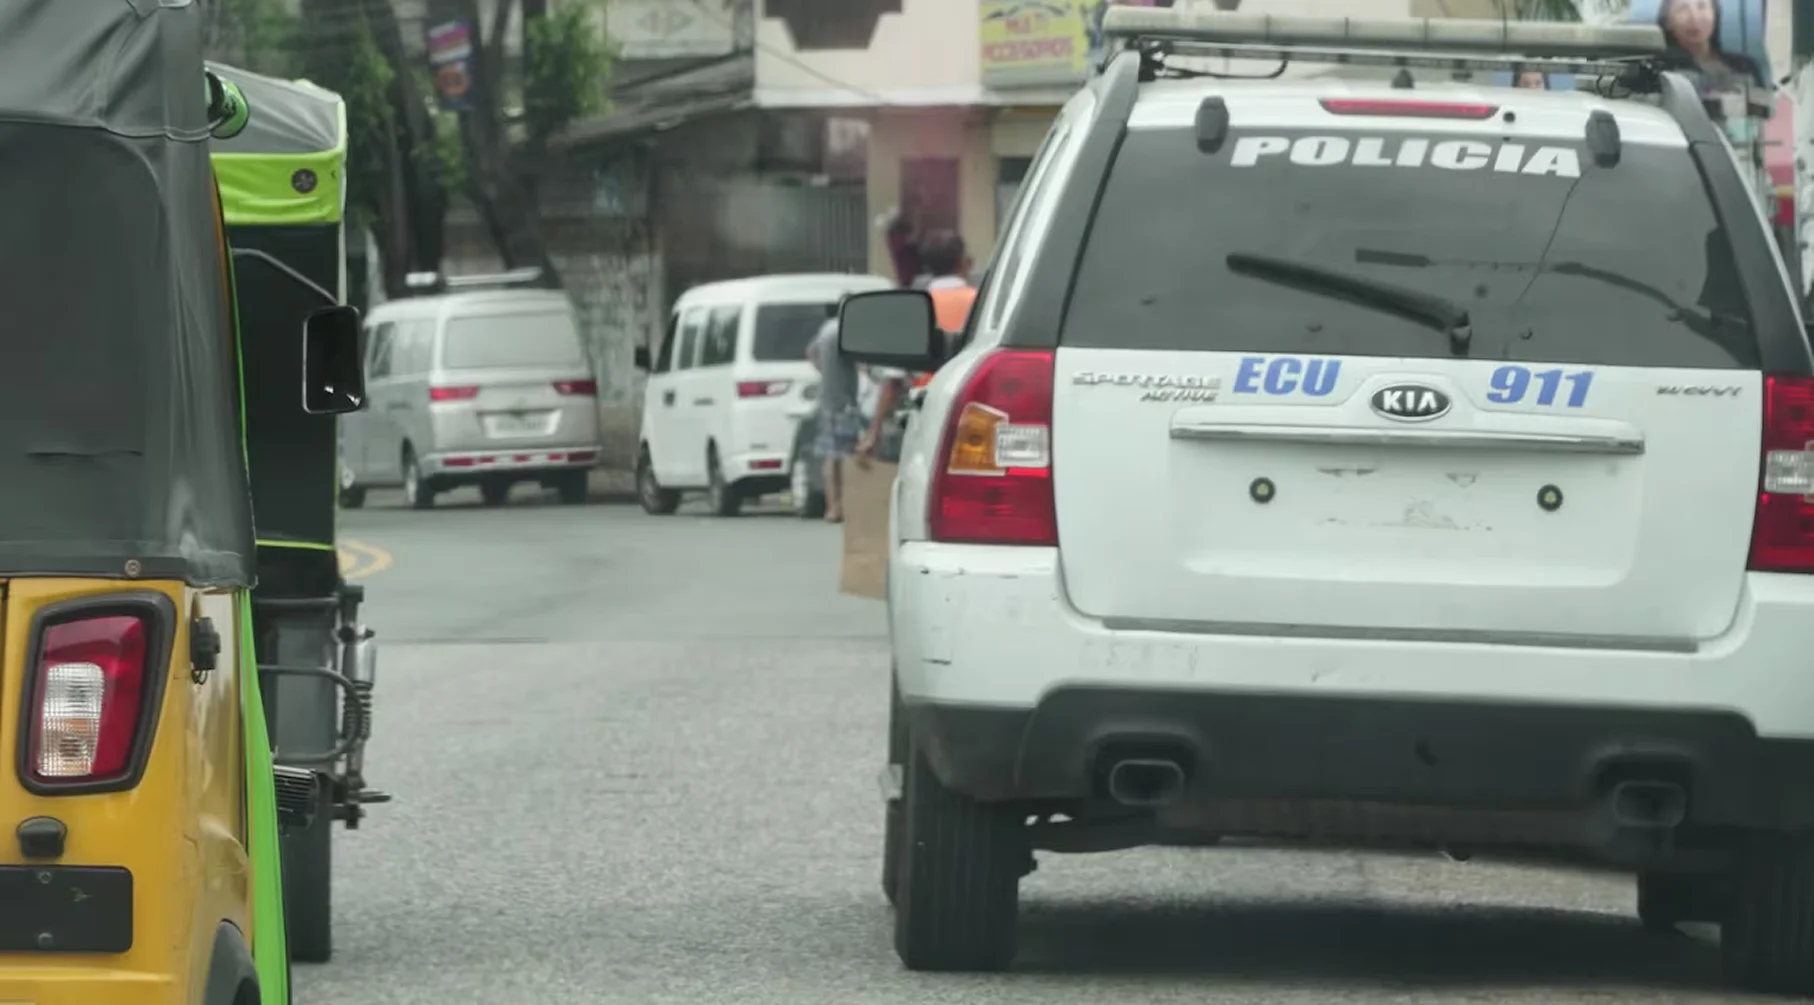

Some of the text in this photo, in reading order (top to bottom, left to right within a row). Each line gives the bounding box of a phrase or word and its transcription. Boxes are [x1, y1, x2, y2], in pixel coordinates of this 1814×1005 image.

[1230, 136, 1581, 178] POLICIA
[1232, 357, 1595, 409] ECU 911
[1381, 388, 1439, 414] KIA
